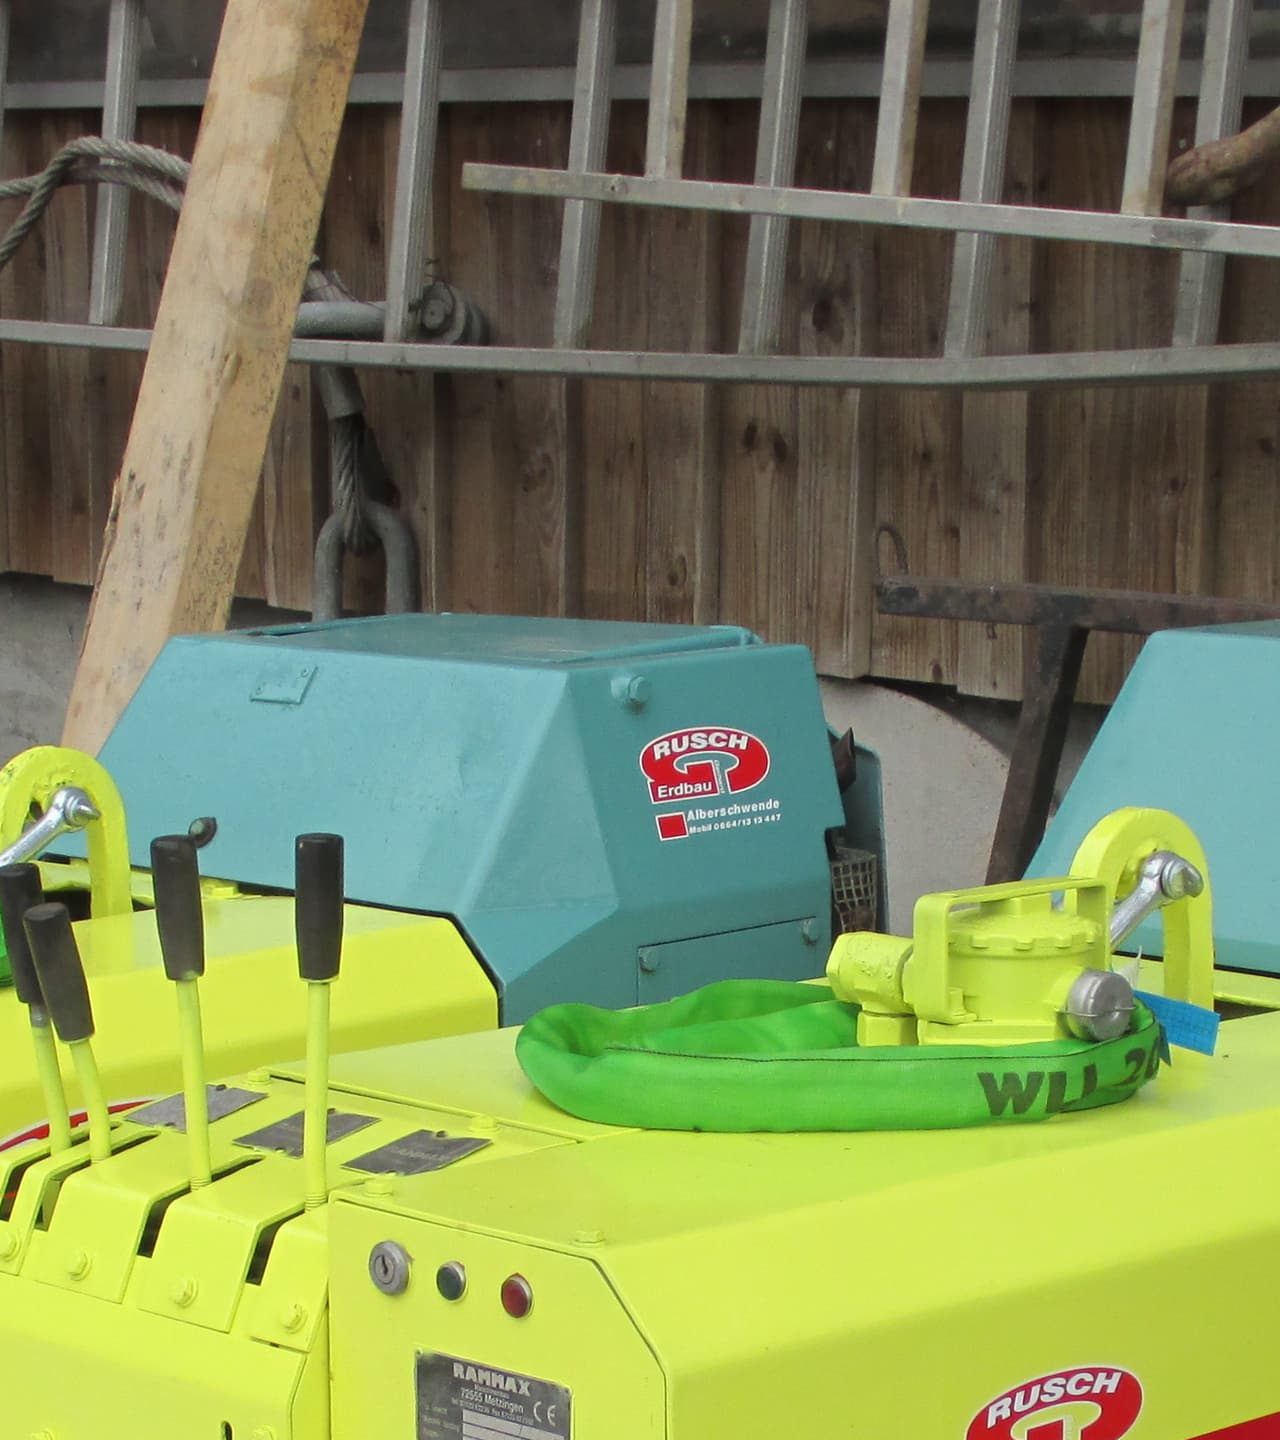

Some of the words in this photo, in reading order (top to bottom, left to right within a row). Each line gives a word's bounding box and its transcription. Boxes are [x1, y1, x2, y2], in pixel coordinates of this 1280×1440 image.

[653, 732, 748, 760] RUSCH
[657, 781, 713, 799] Erdbau
[686, 798, 780, 822] Alberschwende
[453, 1362, 531, 1397] RAMMAX
[986, 1371, 1122, 1429] RUSCH
